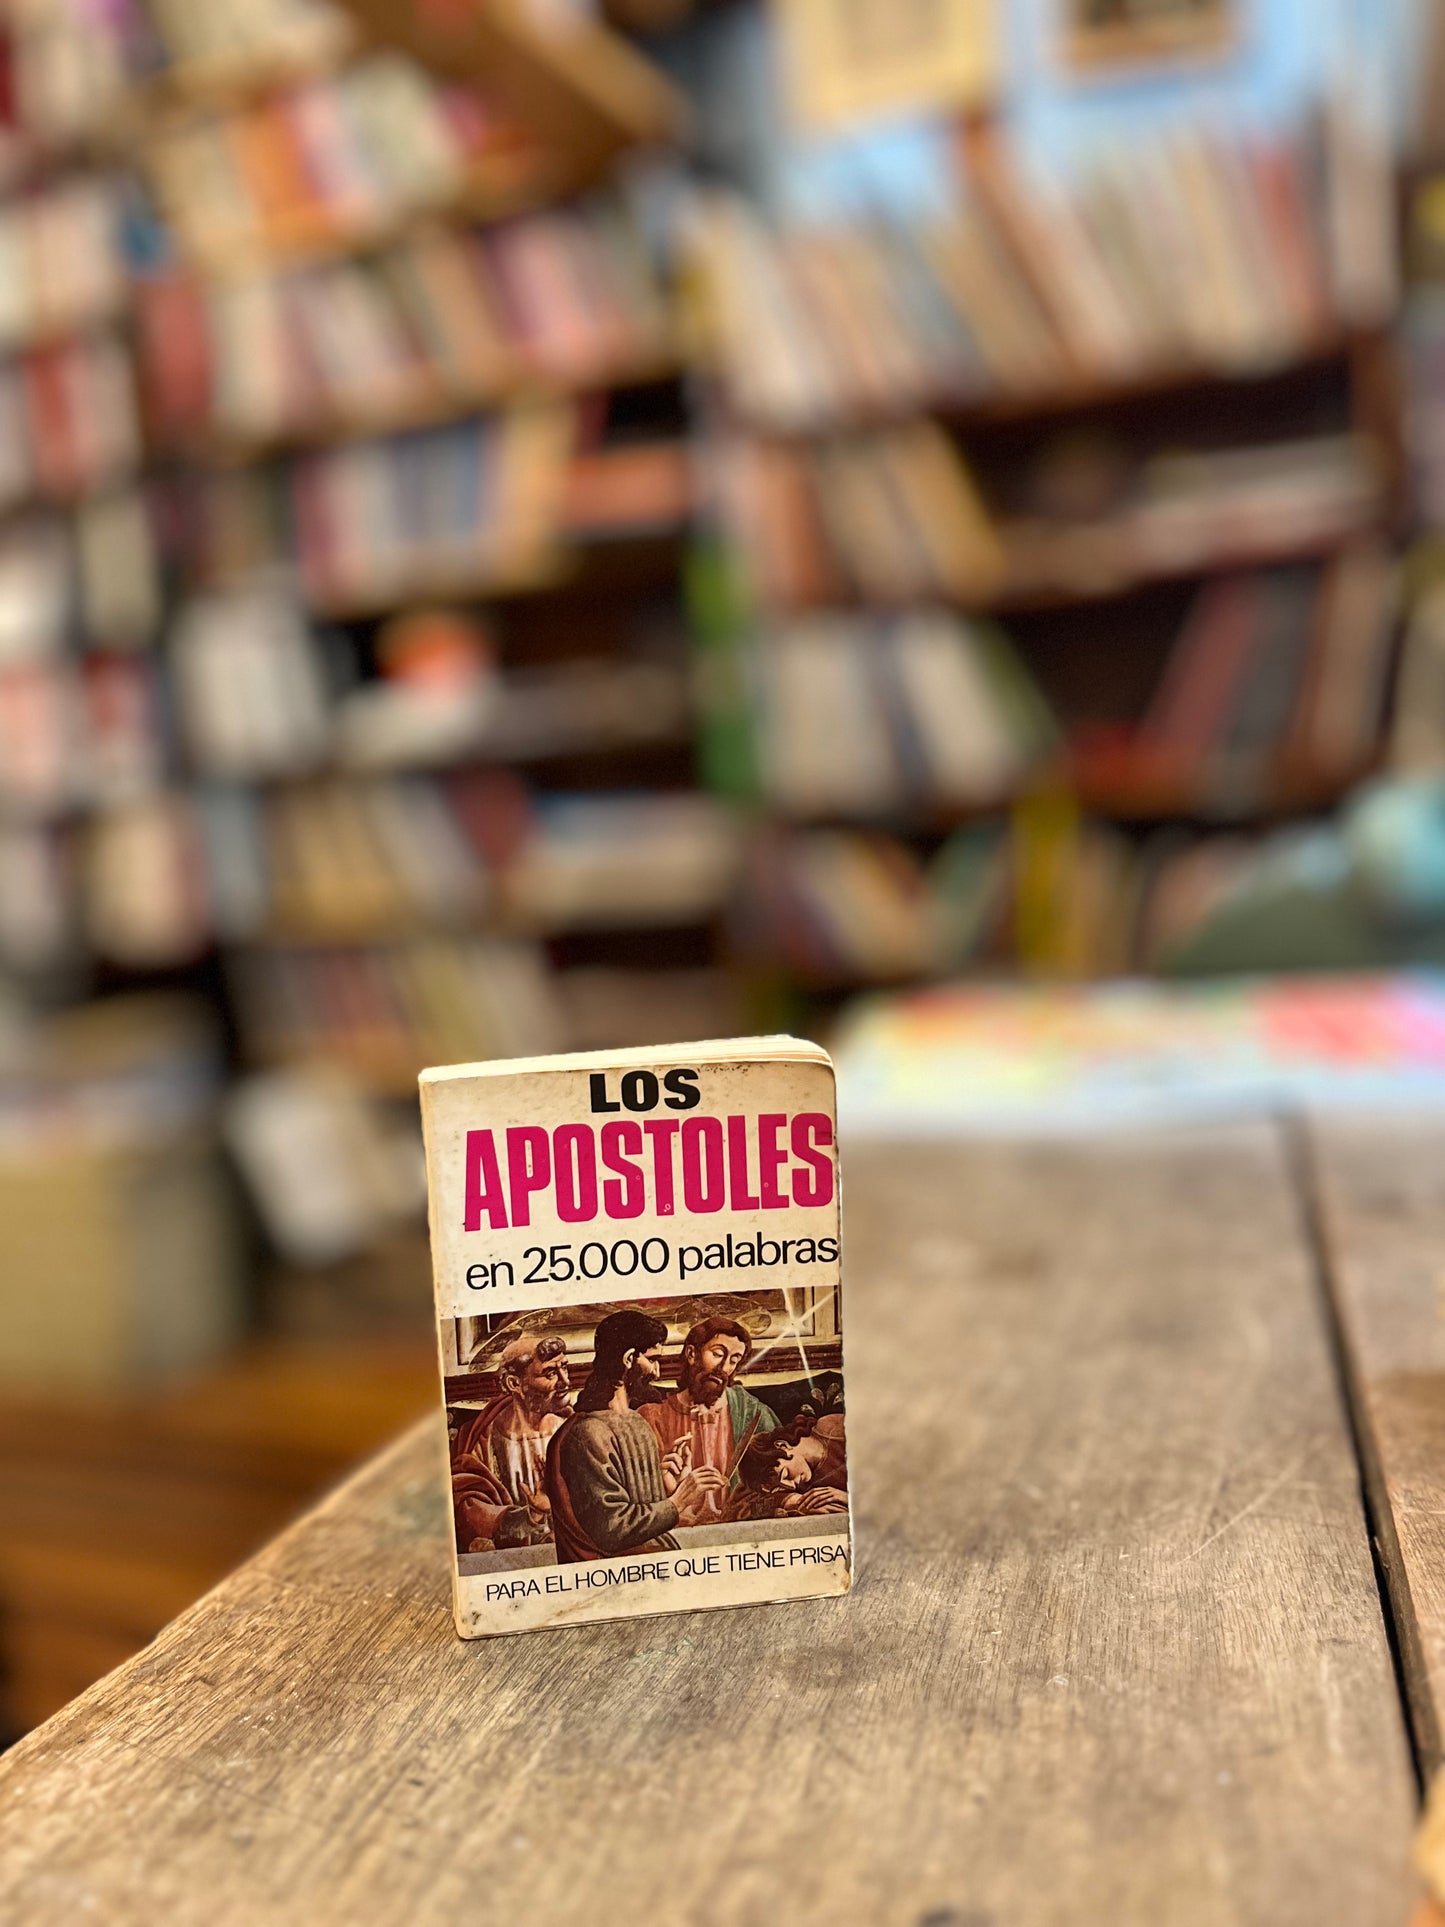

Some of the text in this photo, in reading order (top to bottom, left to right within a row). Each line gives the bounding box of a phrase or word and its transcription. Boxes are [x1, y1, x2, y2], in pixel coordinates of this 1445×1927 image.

[589, 1069, 700, 1112] LOS
[464, 1113, 834, 1232] APOSTOLES
[466, 1232, 839, 1290] en 25.000 palabras
[486, 1544, 848, 1601] PARA EL HOMBRE QUE TIENE PRISA
